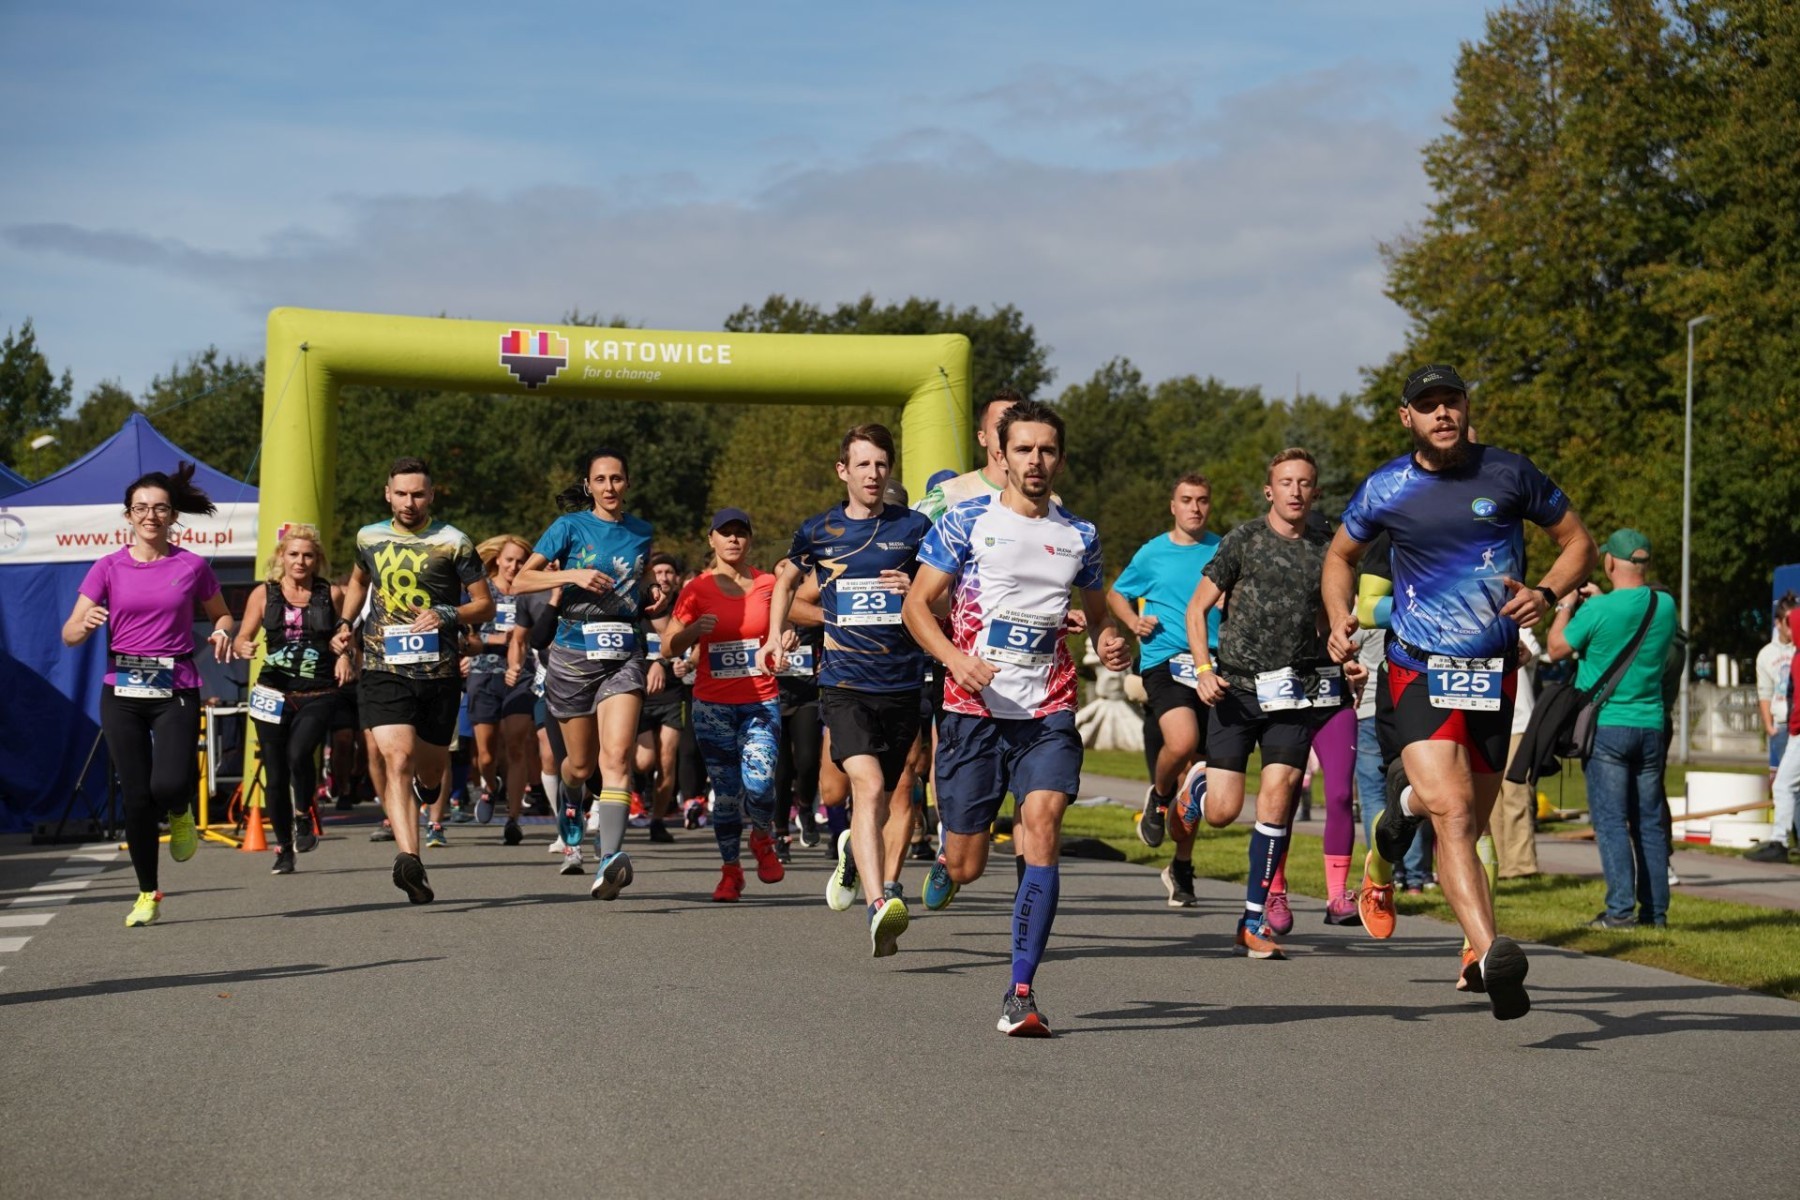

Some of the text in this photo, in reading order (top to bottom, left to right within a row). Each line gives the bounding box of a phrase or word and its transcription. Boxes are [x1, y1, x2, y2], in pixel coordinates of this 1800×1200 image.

[584, 339, 733, 365] KATOWICE
[583, 364, 662, 382] for a change
[56, 529, 234, 547] www.tig4u.pl
[852, 592, 887, 610] 23
[398, 635, 424, 651] 10
[597, 633, 624, 648] 63
[1007, 625, 1048, 648] 57
[721, 651, 749, 667] 69
[127, 668, 159, 685] 37
[1437, 671, 1491, 693] 125
[252, 694, 278, 712] 128
[1014, 881, 1043, 952] kalenji
